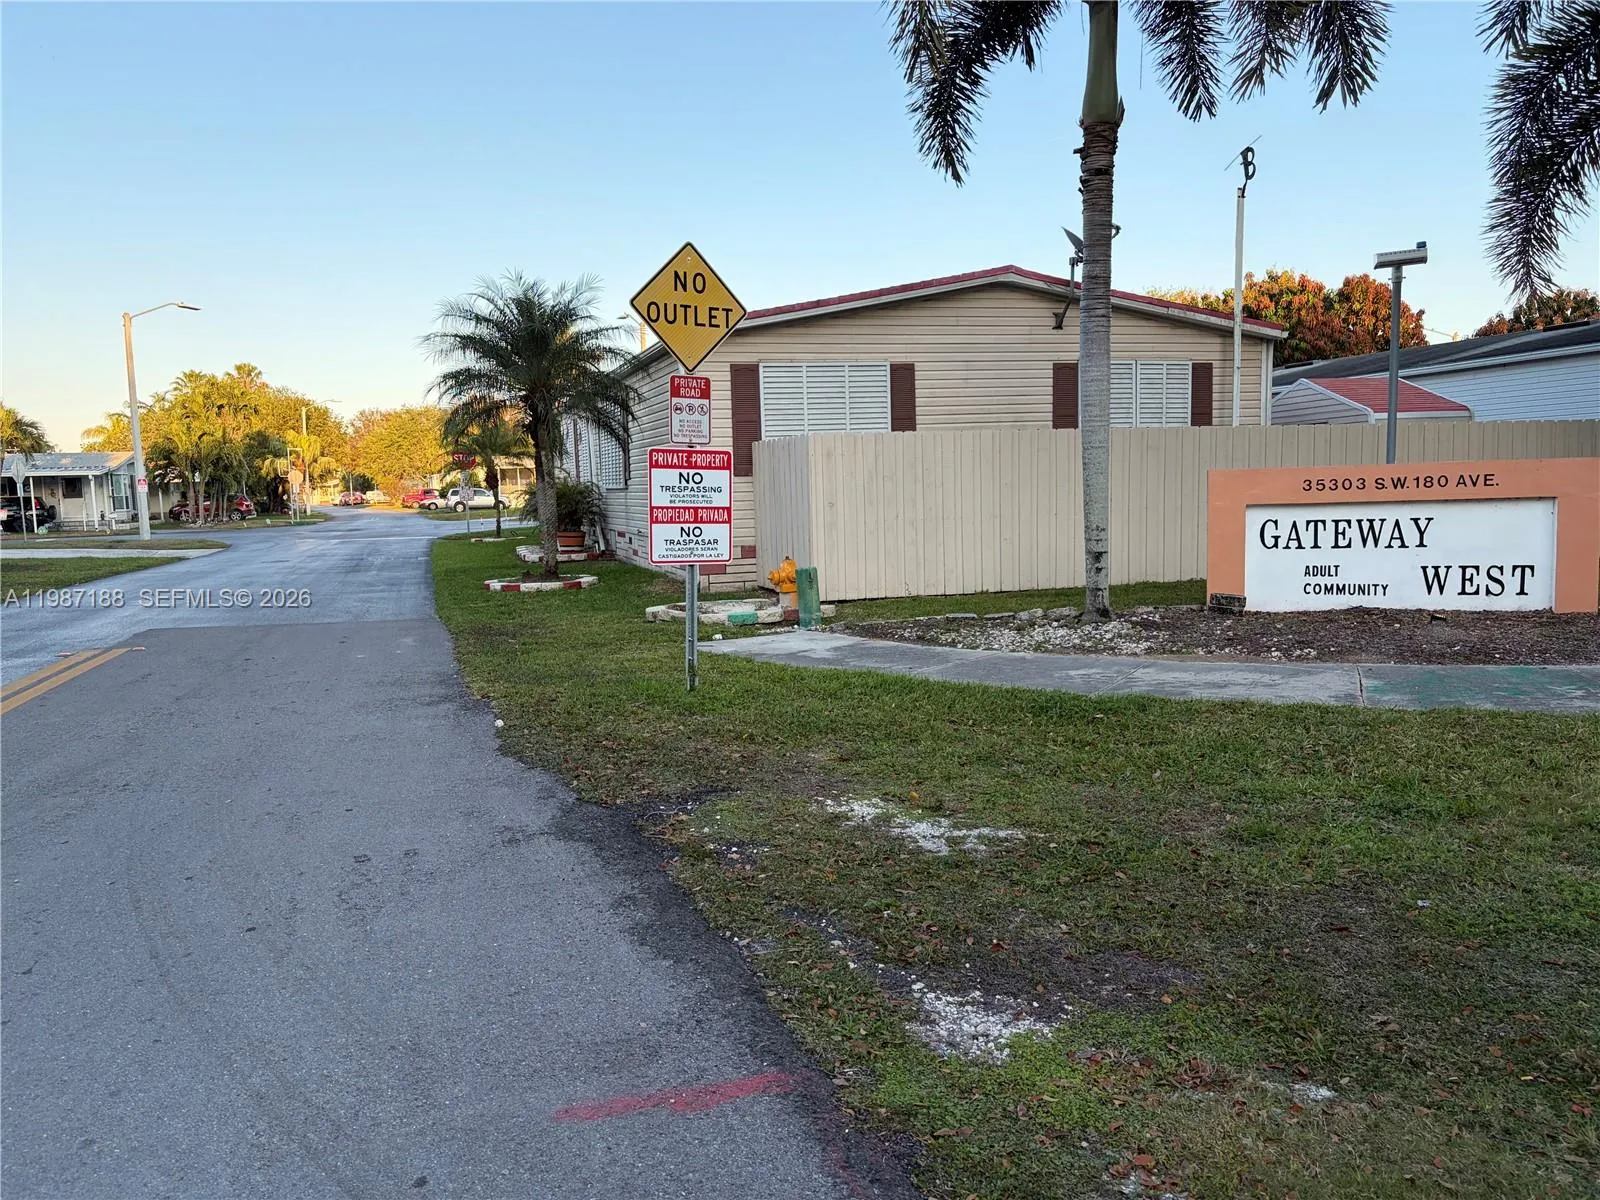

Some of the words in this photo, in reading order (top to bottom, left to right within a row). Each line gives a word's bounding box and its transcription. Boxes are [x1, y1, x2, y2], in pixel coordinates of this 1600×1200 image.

[673, 270, 707, 294] NO
[646, 301, 733, 329] OUTLET
[674, 377, 706, 389] PRIVATE
[680, 387, 701, 397] ROAD
[652, 452, 688, 466] PRIVATE
[692, 453, 728, 467] PROPERTY
[679, 472, 703, 485] NO
[1302, 477, 1367, 492] 35303
[1455, 473, 1500, 488] AVE.
[660, 485, 722, 493] TRESPASSING
[653, 509, 695, 522] PROPIEDAD
[698, 509, 728, 522] PRIVADA
[680, 526, 703, 538] NO
[1259, 517, 1434, 550] GATEWAY
[1304, 564, 1340, 577] ADULT
[1420, 565, 1536, 597] WEST
[1303, 583, 1390, 597] COMMUNITY
